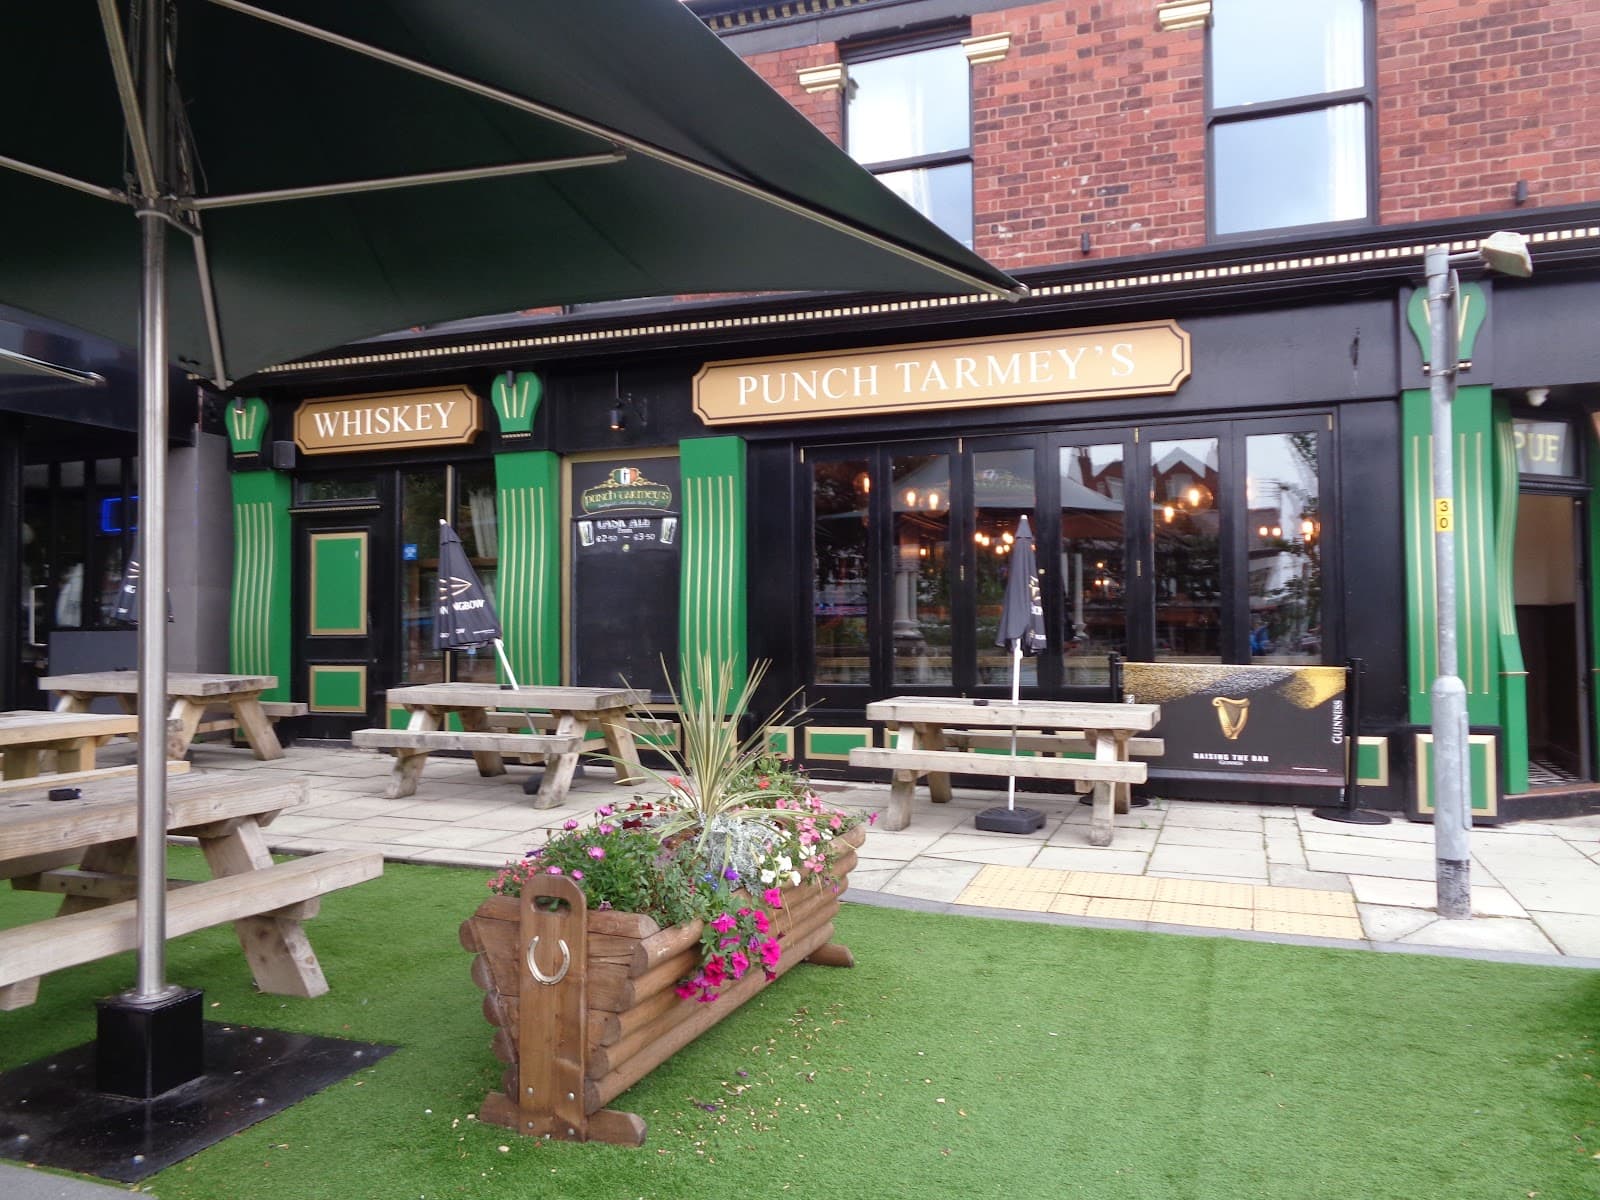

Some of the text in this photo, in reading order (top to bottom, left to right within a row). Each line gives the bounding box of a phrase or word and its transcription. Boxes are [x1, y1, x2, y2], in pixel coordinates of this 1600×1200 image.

[737, 342, 1137, 406] PUNCH TARMEY'S
[313, 400, 457, 439] WHISKEY
[1331, 699, 1343, 744] GUINNESS
[1231, 754, 1249, 762] THE
